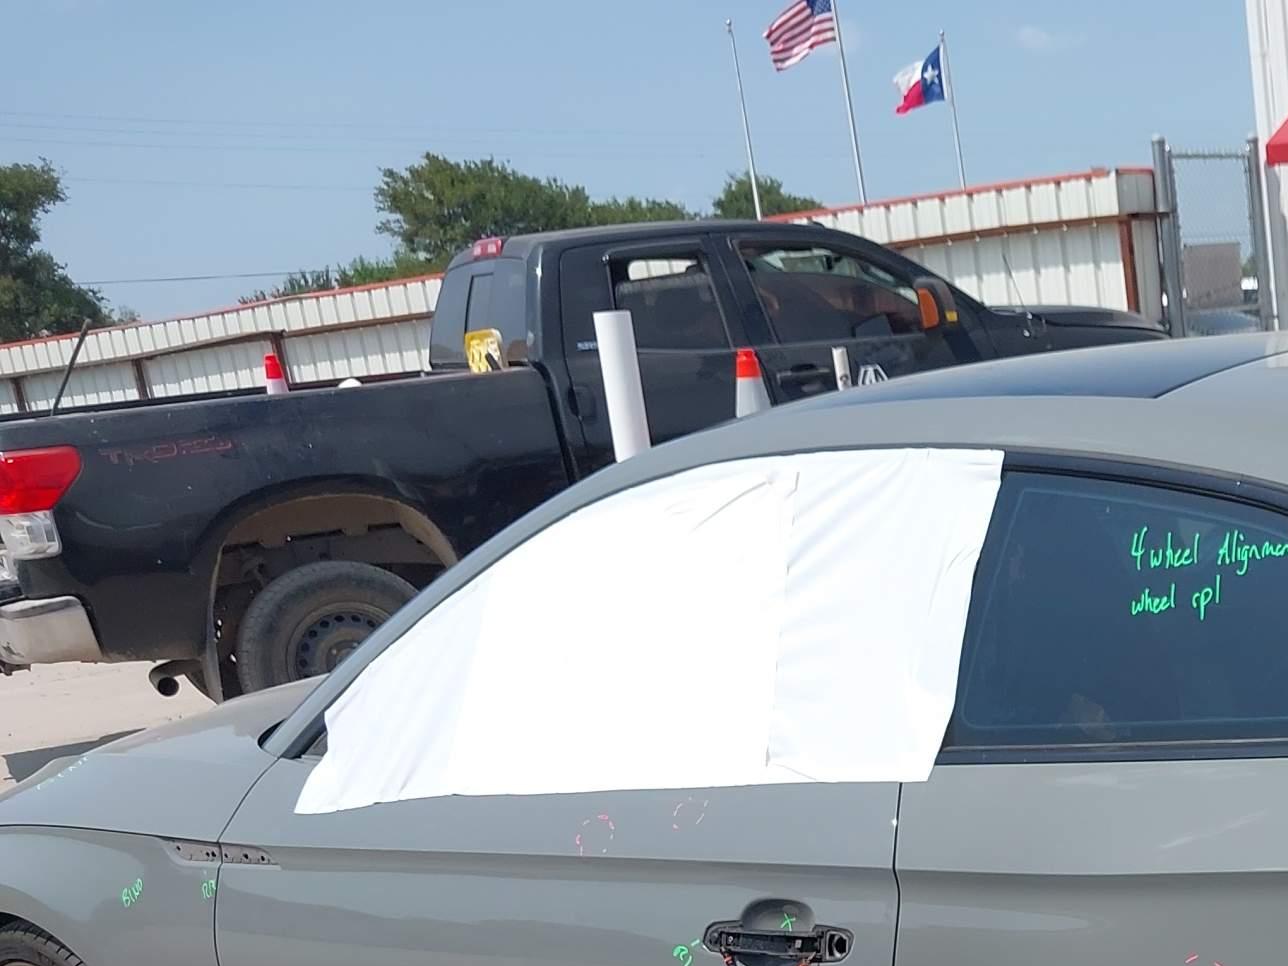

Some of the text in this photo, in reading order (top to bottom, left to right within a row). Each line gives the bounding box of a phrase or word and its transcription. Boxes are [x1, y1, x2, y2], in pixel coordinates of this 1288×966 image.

[1131, 526, 1148, 571] 4
[1150, 532, 1199, 569] wheel
[1131, 574, 1221, 621] wheel rpl
